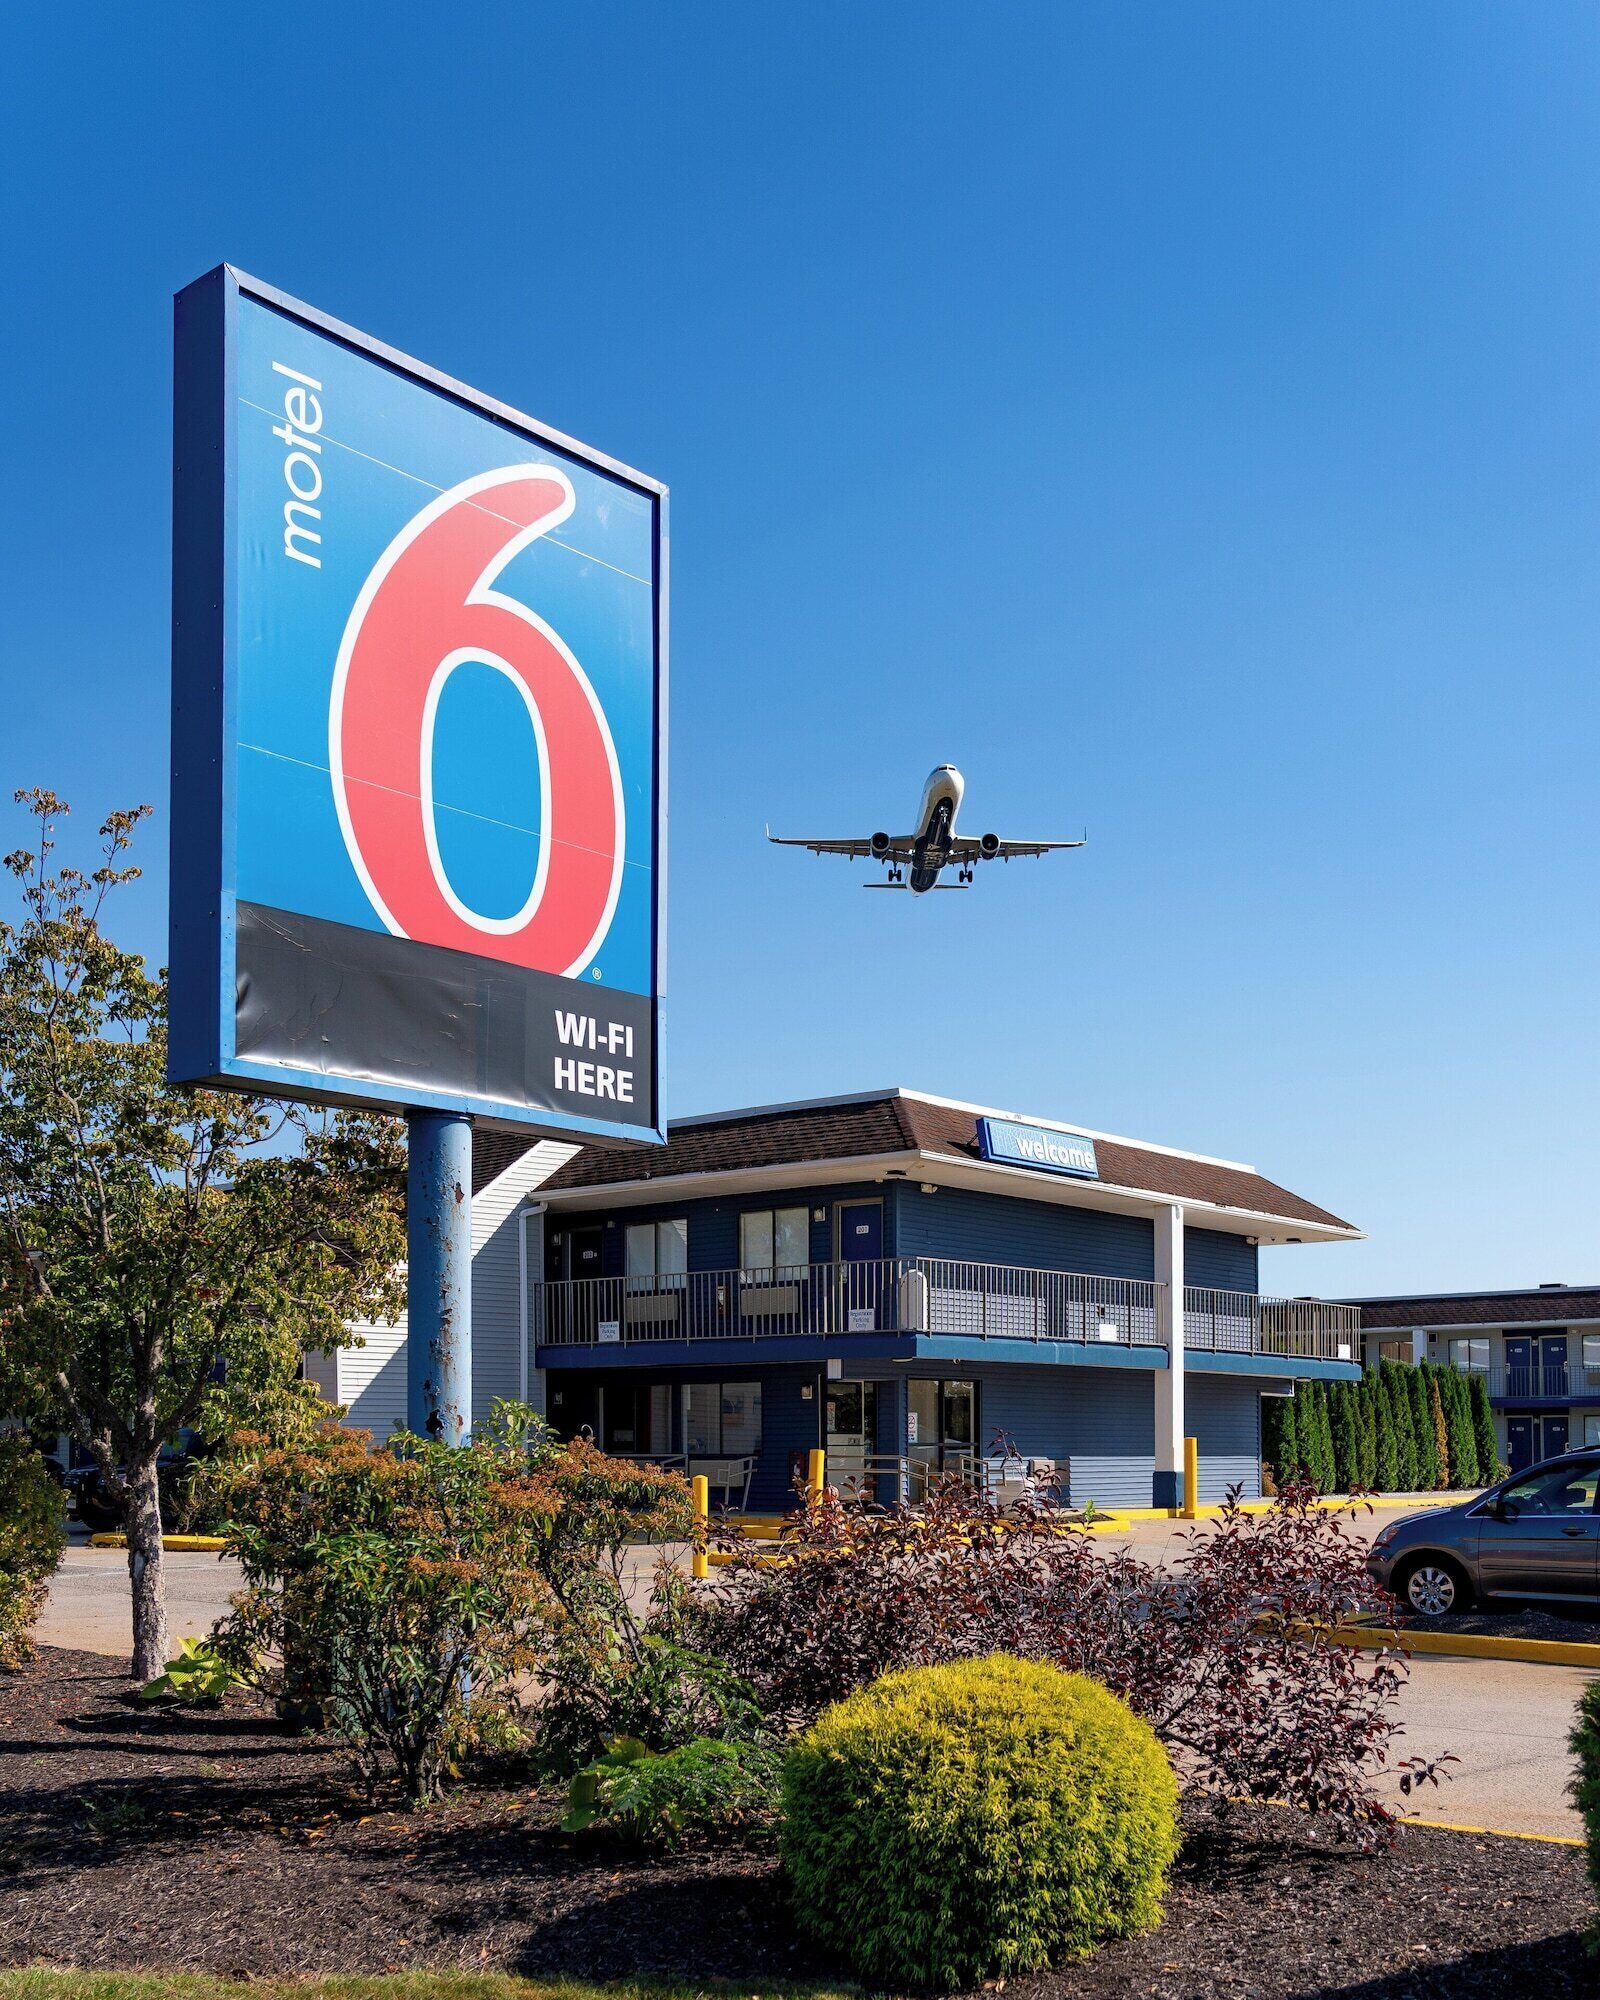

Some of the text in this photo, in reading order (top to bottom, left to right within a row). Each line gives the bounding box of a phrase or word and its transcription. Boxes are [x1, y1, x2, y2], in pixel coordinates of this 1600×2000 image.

[272, 361, 323, 569] motel
[328, 463, 626, 980] 6
[554, 1010, 634, 1058] WI-FI
[554, 1057, 634, 1104] HERE
[1016, 1135, 1095, 1169] welcome
